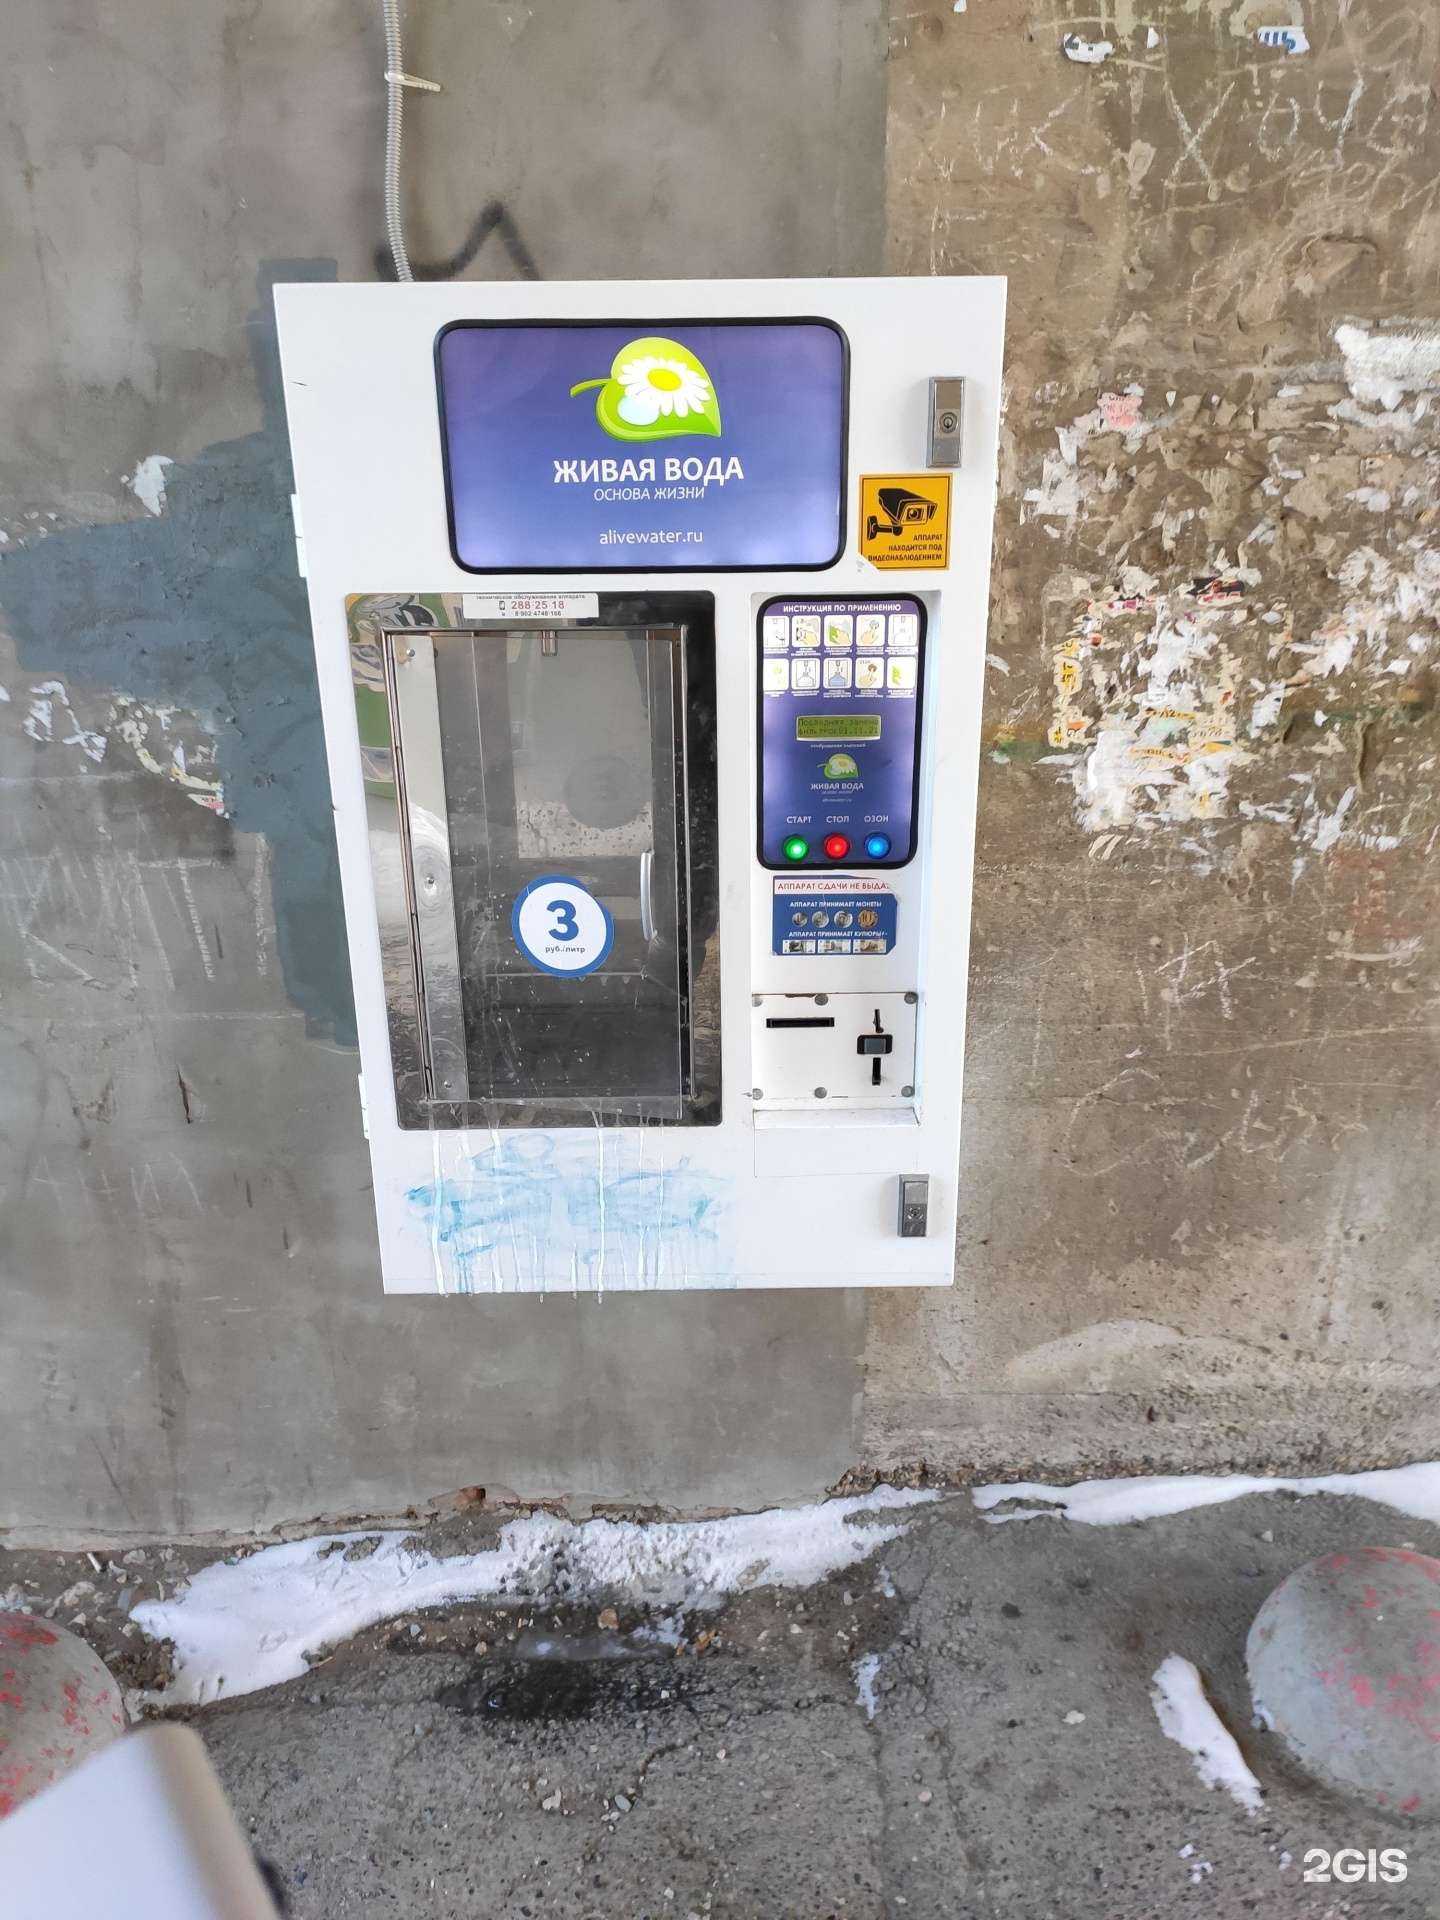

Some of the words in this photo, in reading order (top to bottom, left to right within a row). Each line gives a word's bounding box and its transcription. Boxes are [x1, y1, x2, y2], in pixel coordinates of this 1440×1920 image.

[553, 459, 656, 483] ЖИВАЯ
[665, 457, 745, 487] ВОДА
[593, 487, 650, 501] ОСНОВА
[654, 486, 705, 500] ЖИЗНИ
[599, 529, 704, 545] alivewater.ru
[889, 544, 927, 552] НАХОДИТСЯ
[868, 554, 942, 562] ВИДЕОНАБЛЮДЕНИЕМ
[783, 604, 832, 613] ИНСТРУКЦИЯ
[834, 604, 846, 612] ПО
[848, 603, 902, 612] ПРИМЕНЕНИЮ
[810, 782, 840, 790] ЖИВАЯ
[841, 782, 864, 792] ВОДА
[786, 816, 811, 824] СТАРТ
[826, 815, 850, 824] СТОП
[864, 814, 889, 823] ОЗОН
[817, 882, 848, 890] СДАЧИ
[850, 882, 860, 890] НЕ
[546, 899, 580, 942] 3
